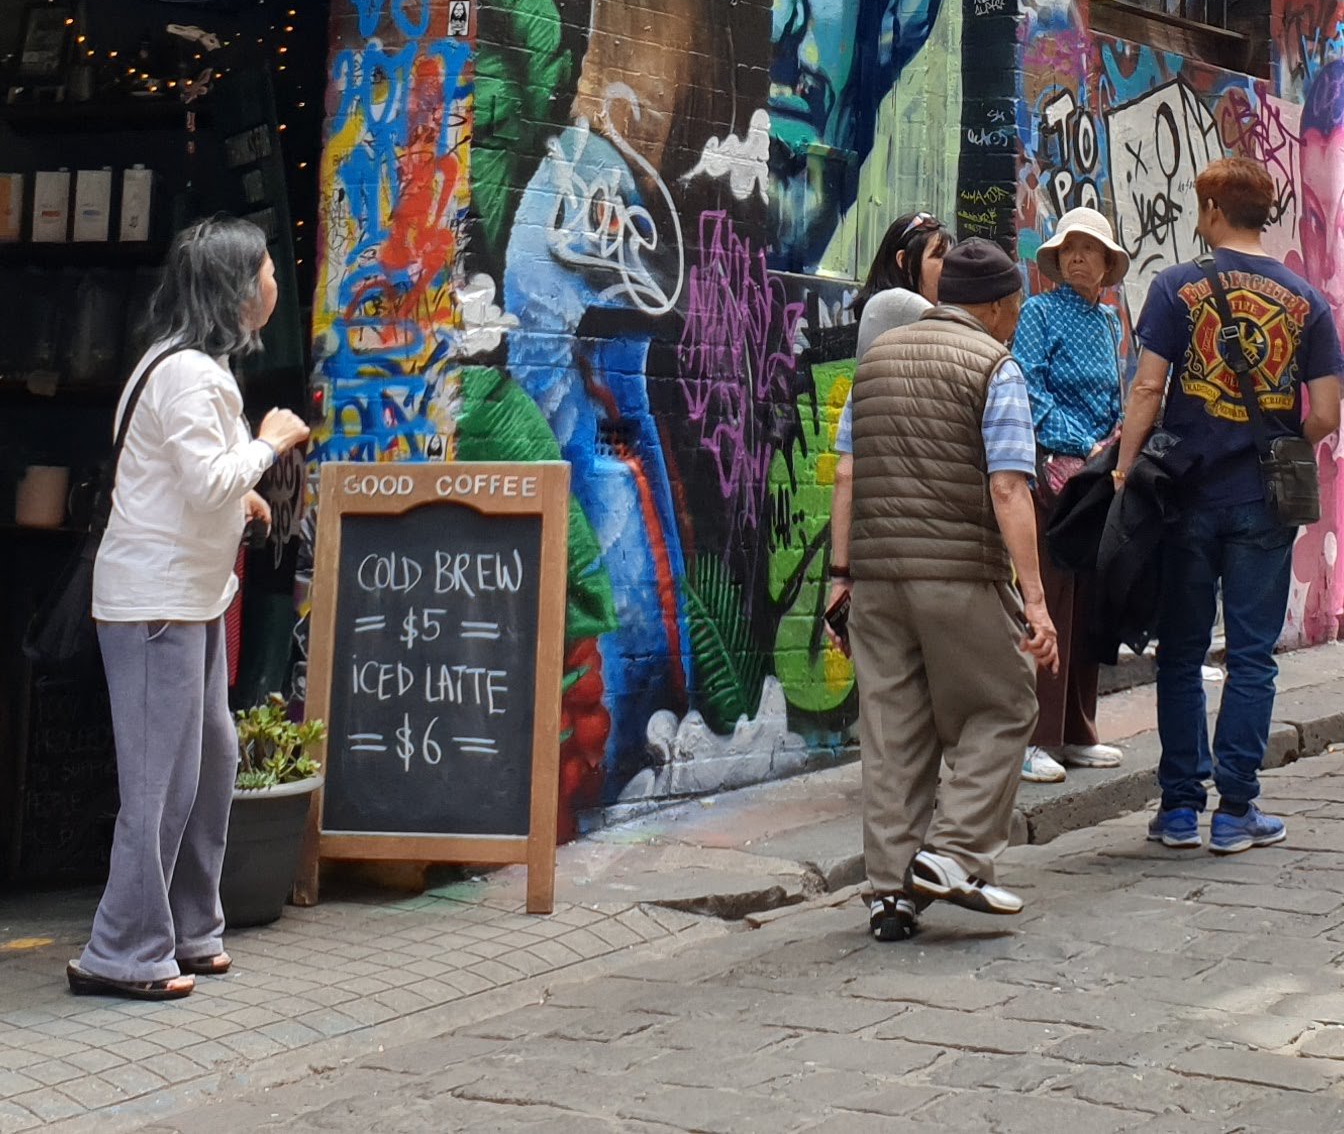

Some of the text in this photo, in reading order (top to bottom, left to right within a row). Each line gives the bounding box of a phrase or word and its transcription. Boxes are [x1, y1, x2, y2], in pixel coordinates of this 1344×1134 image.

[1231, 299, 1257, 313] FIRE
[343, 473, 537, 499] GOOD COFFEE
[357, 549, 523, 598] COLD BREW
[399, 606, 447, 650] $5
[425, 663, 509, 715] LATTE
[395, 712, 442, 773] $6
